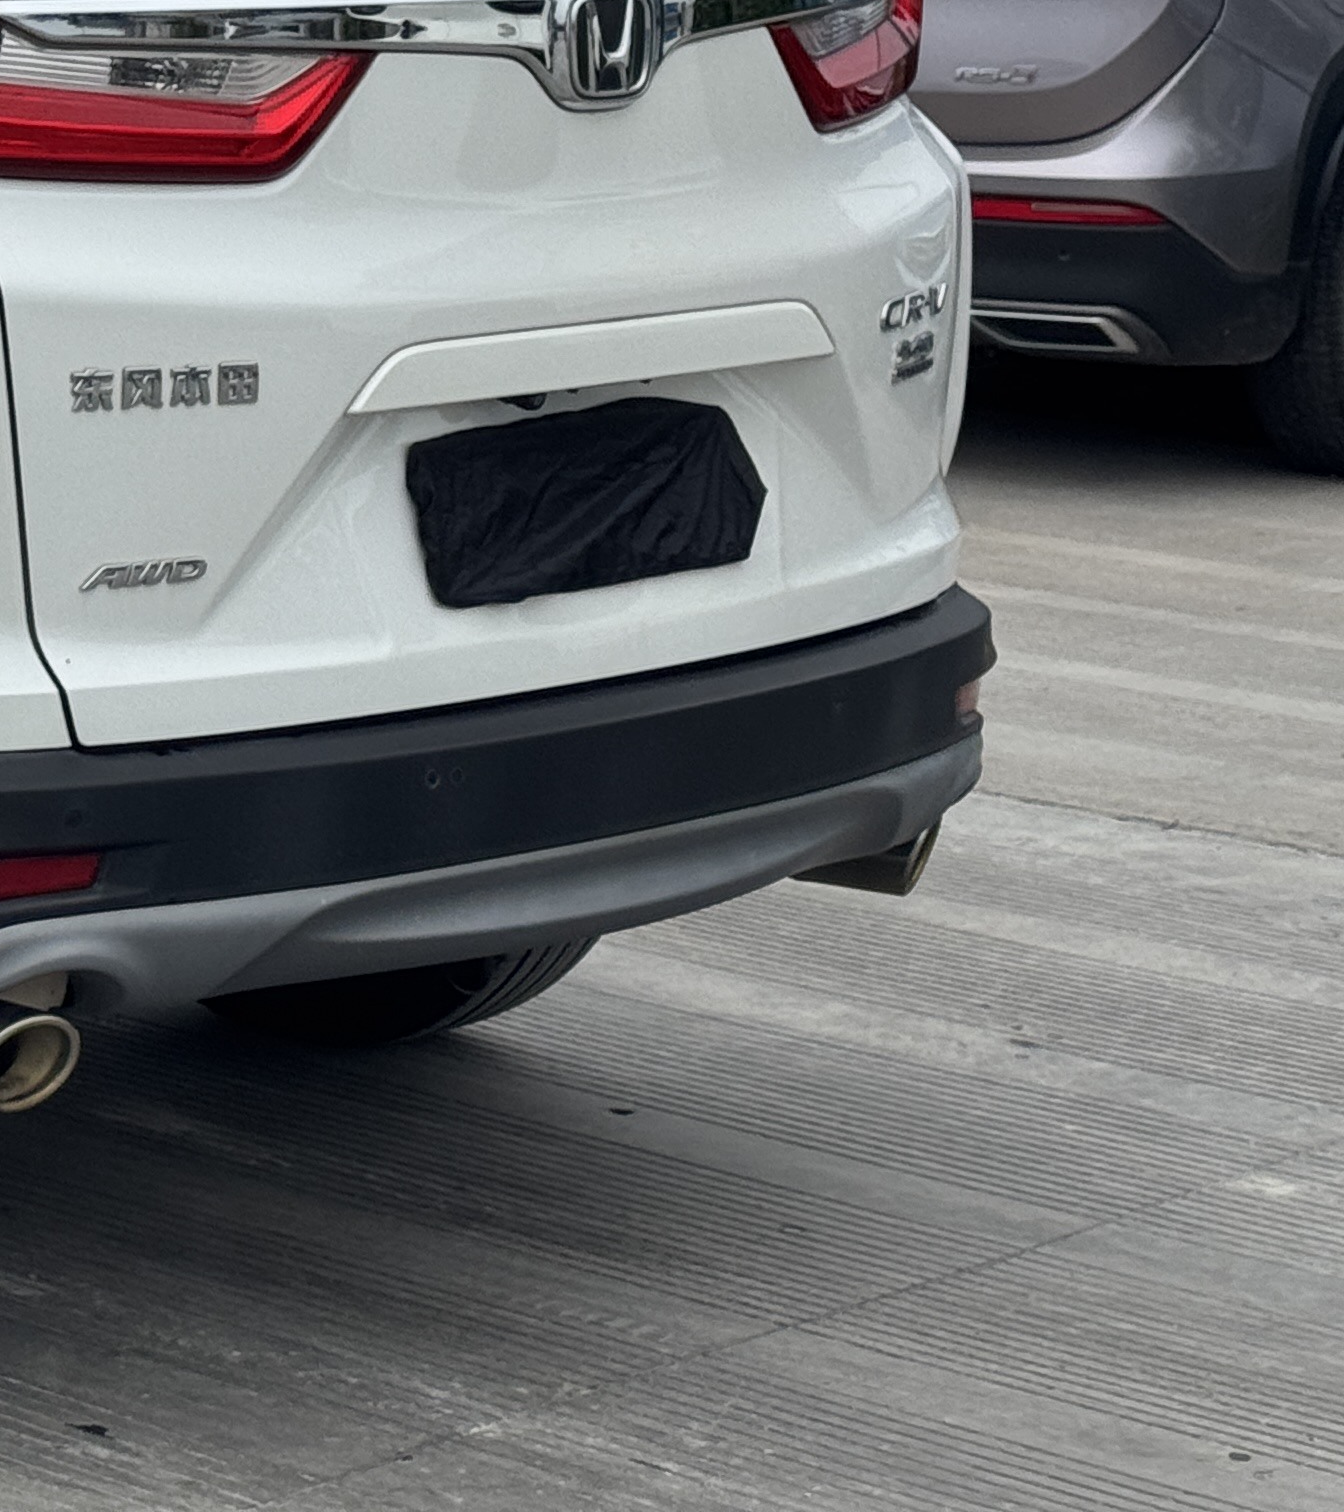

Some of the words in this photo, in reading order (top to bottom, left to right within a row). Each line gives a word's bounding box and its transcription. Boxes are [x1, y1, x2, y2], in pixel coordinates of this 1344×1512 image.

[879, 282, 949, 332] CR-V
[70, 361, 260, 413] 东风本田
[78, 556, 209, 593] AWD
